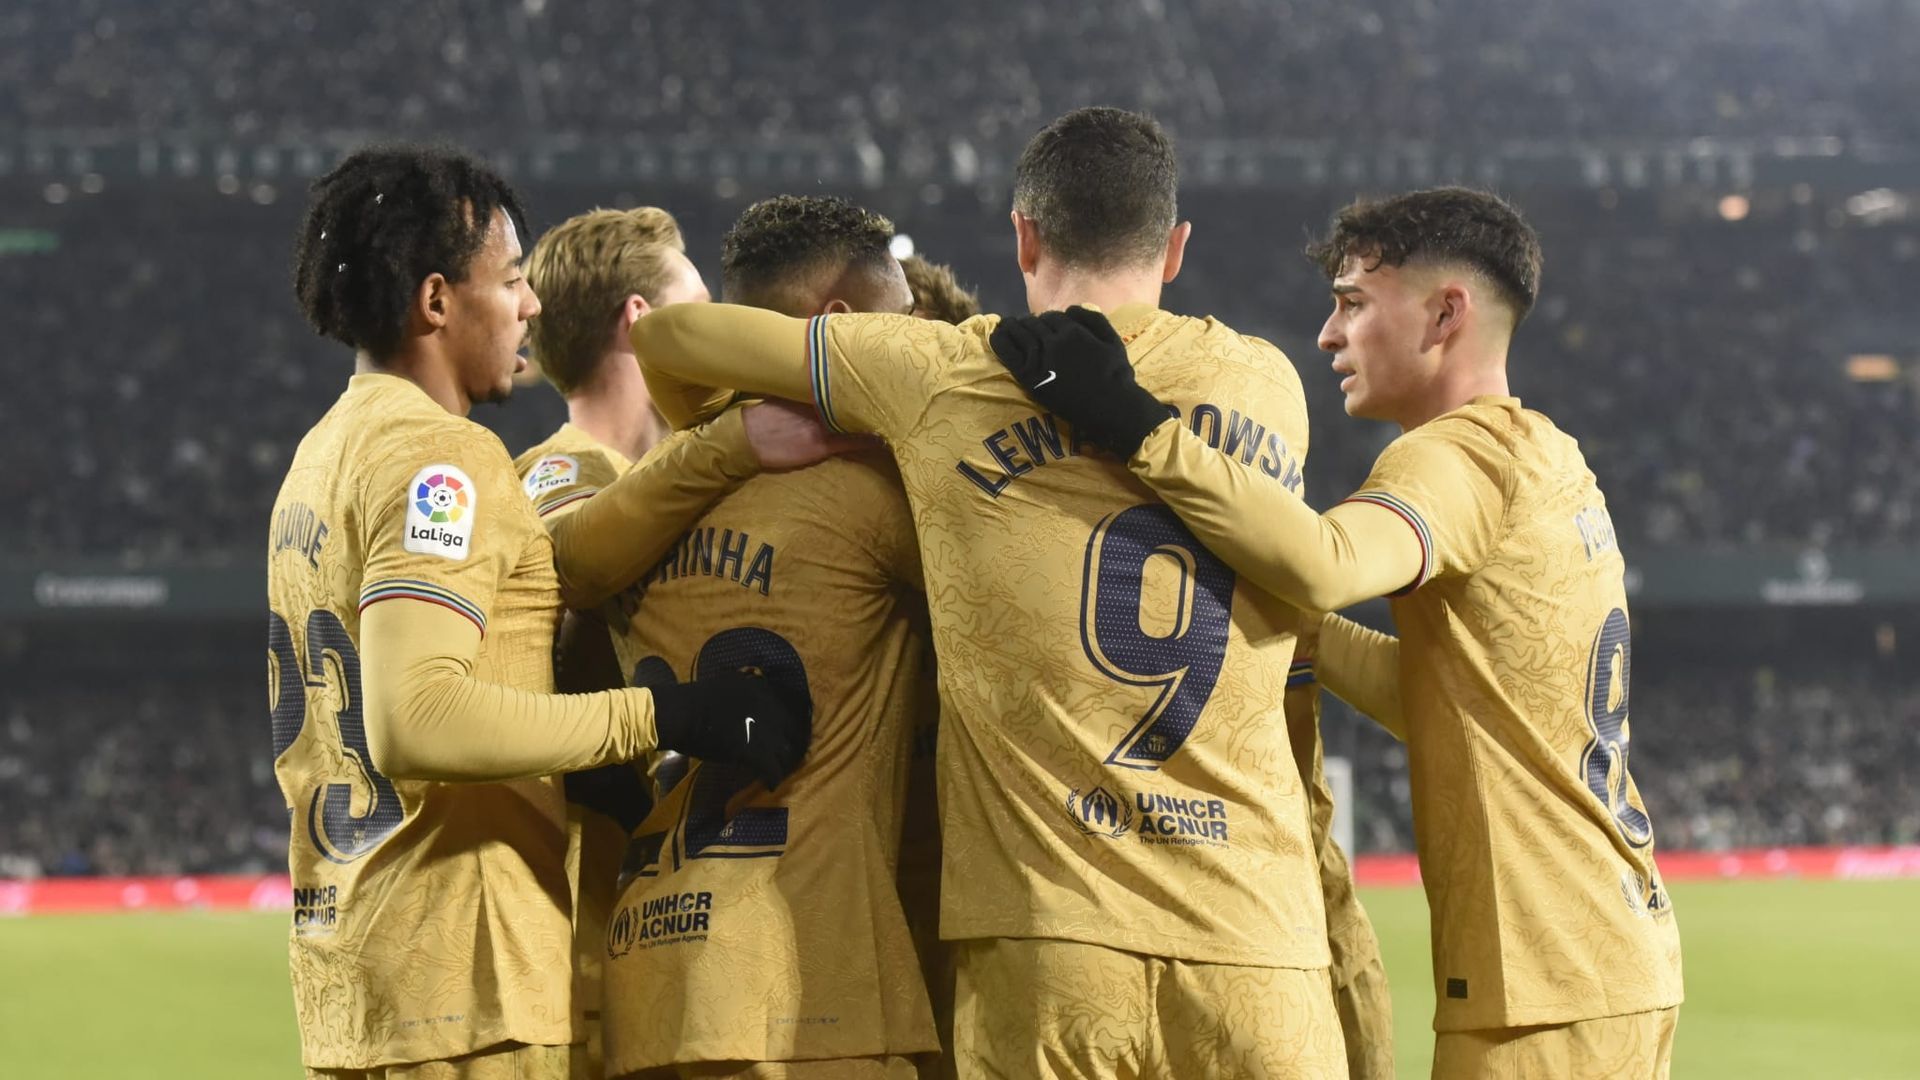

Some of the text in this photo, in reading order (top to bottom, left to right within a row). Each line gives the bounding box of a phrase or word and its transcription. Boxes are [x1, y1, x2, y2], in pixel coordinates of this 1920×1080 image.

[956, 402, 1303, 499] LEWOWSK
[275, 502, 329, 572] OUNDE
[411, 525, 463, 547] LaLiga
[1079, 503, 1236, 771] 9
[1579, 607, 1651, 849] 8
[1136, 792, 1227, 819] UNHCR
[1138, 814, 1228, 841] ACNUR
[1140, 835, 1154, 844] The
[1156, 837, 1169, 845] UN
[1171, 837, 1204, 847] Refugee
[294, 885, 336, 907] NHCR
[642, 891, 712, 920] UNHCR
[295, 906, 336, 926] CNUR
[639, 912, 709, 941] ACNUR
